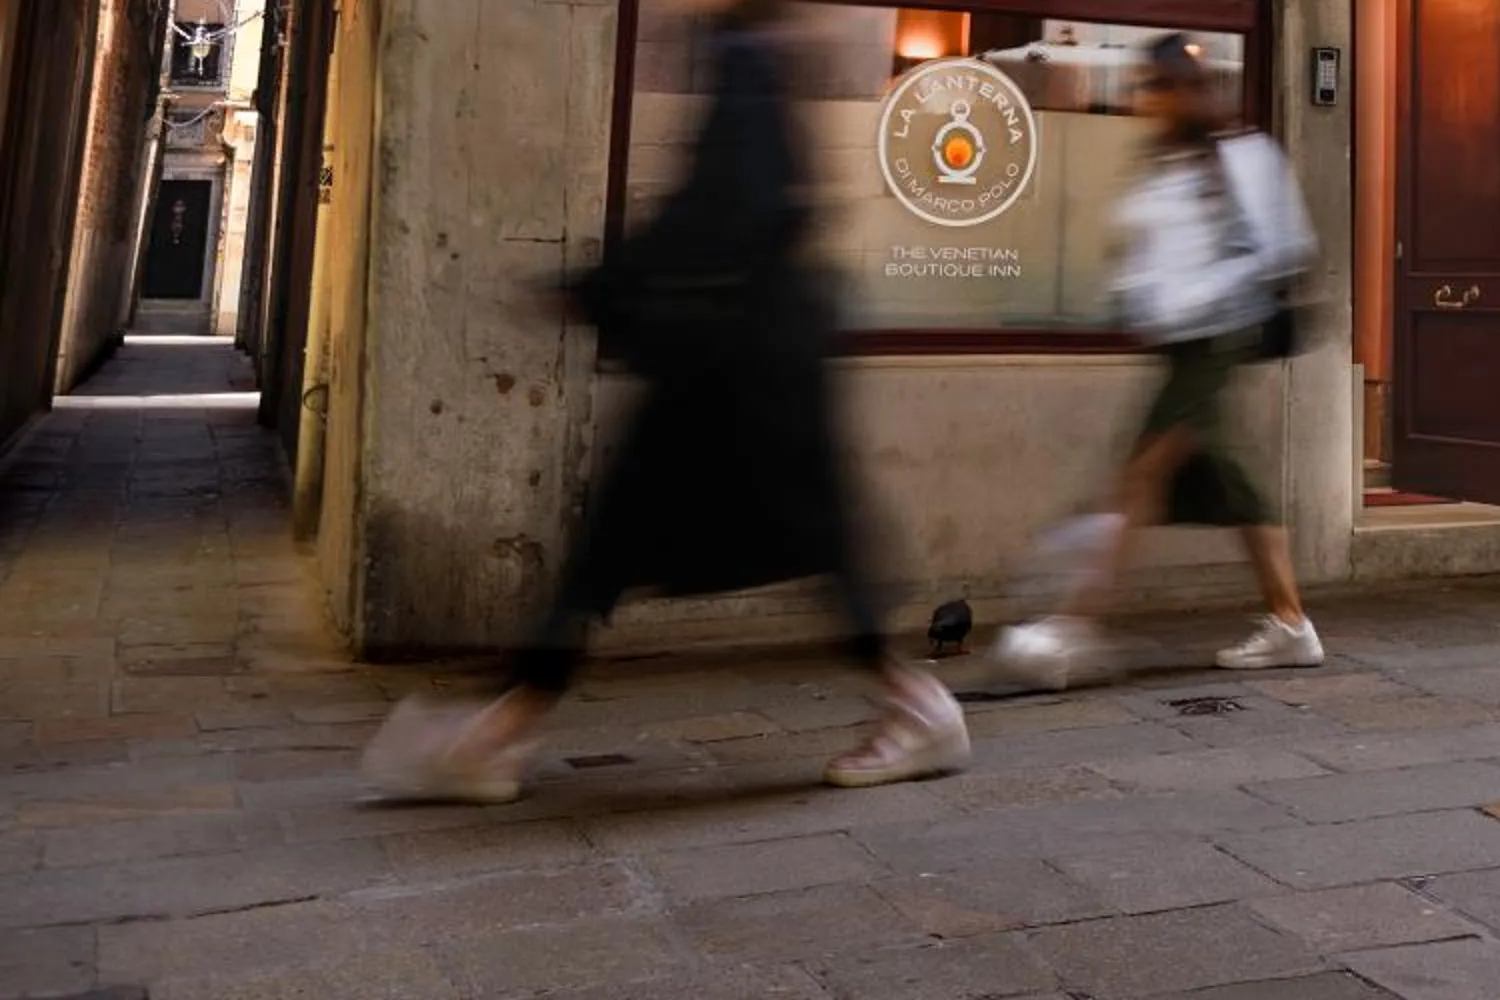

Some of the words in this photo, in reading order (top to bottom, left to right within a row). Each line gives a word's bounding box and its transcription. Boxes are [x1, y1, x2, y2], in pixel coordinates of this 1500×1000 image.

[893, 108, 916, 138] LA
[914, 75, 1023, 144] LANTERNA
[908, 179, 975, 213] MARCO
[978, 162, 1020, 206] POLO
[885, 263, 984, 277] BOUTIQUE
[988, 264, 1021, 277] INN
[891, 247, 925, 260] THE
[929, 247, 1019, 261] VENETIAN
